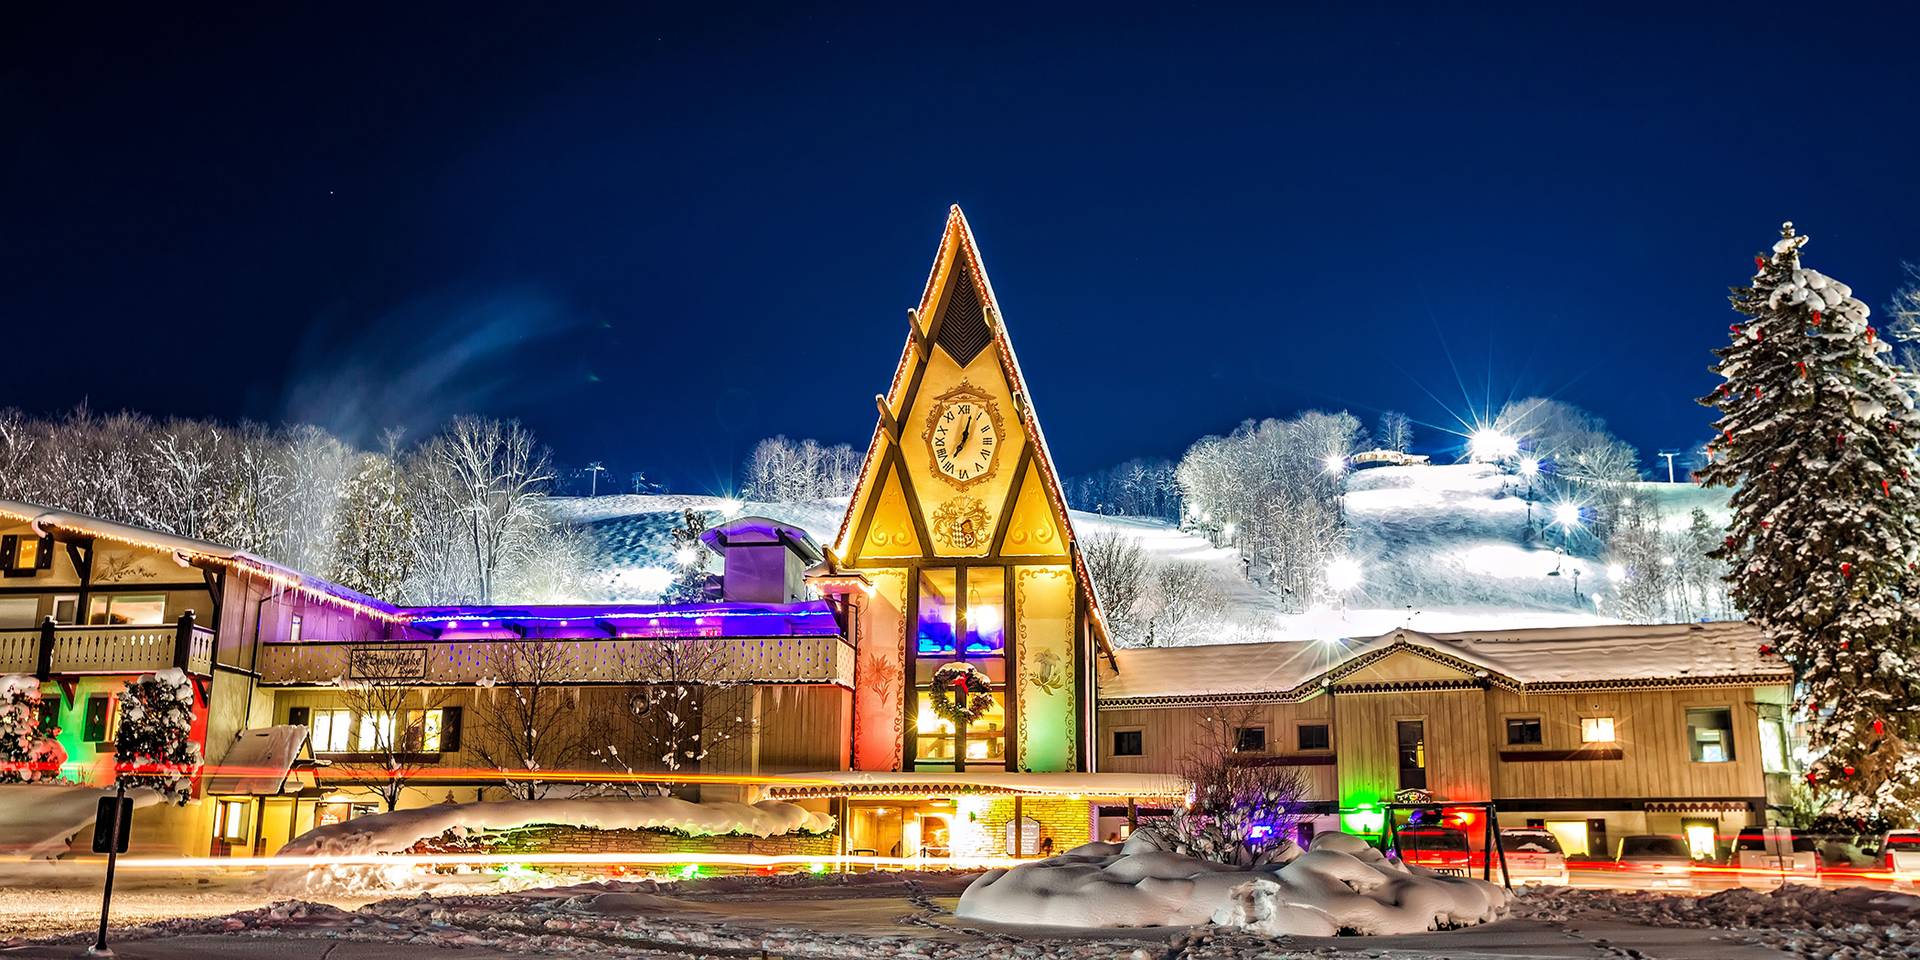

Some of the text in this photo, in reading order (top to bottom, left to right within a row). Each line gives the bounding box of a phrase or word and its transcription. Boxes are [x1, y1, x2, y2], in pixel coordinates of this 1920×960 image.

[958, 405, 970, 415] XII
[937, 425, 948, 435] X
[981, 425, 990, 433] II
[935, 437, 945, 446] IX
[982, 437, 992, 445] III
[980, 449, 991, 460] IV
[942, 461, 954, 474] VII
[975, 463, 984, 472] V
[959, 469, 968, 479] VI
